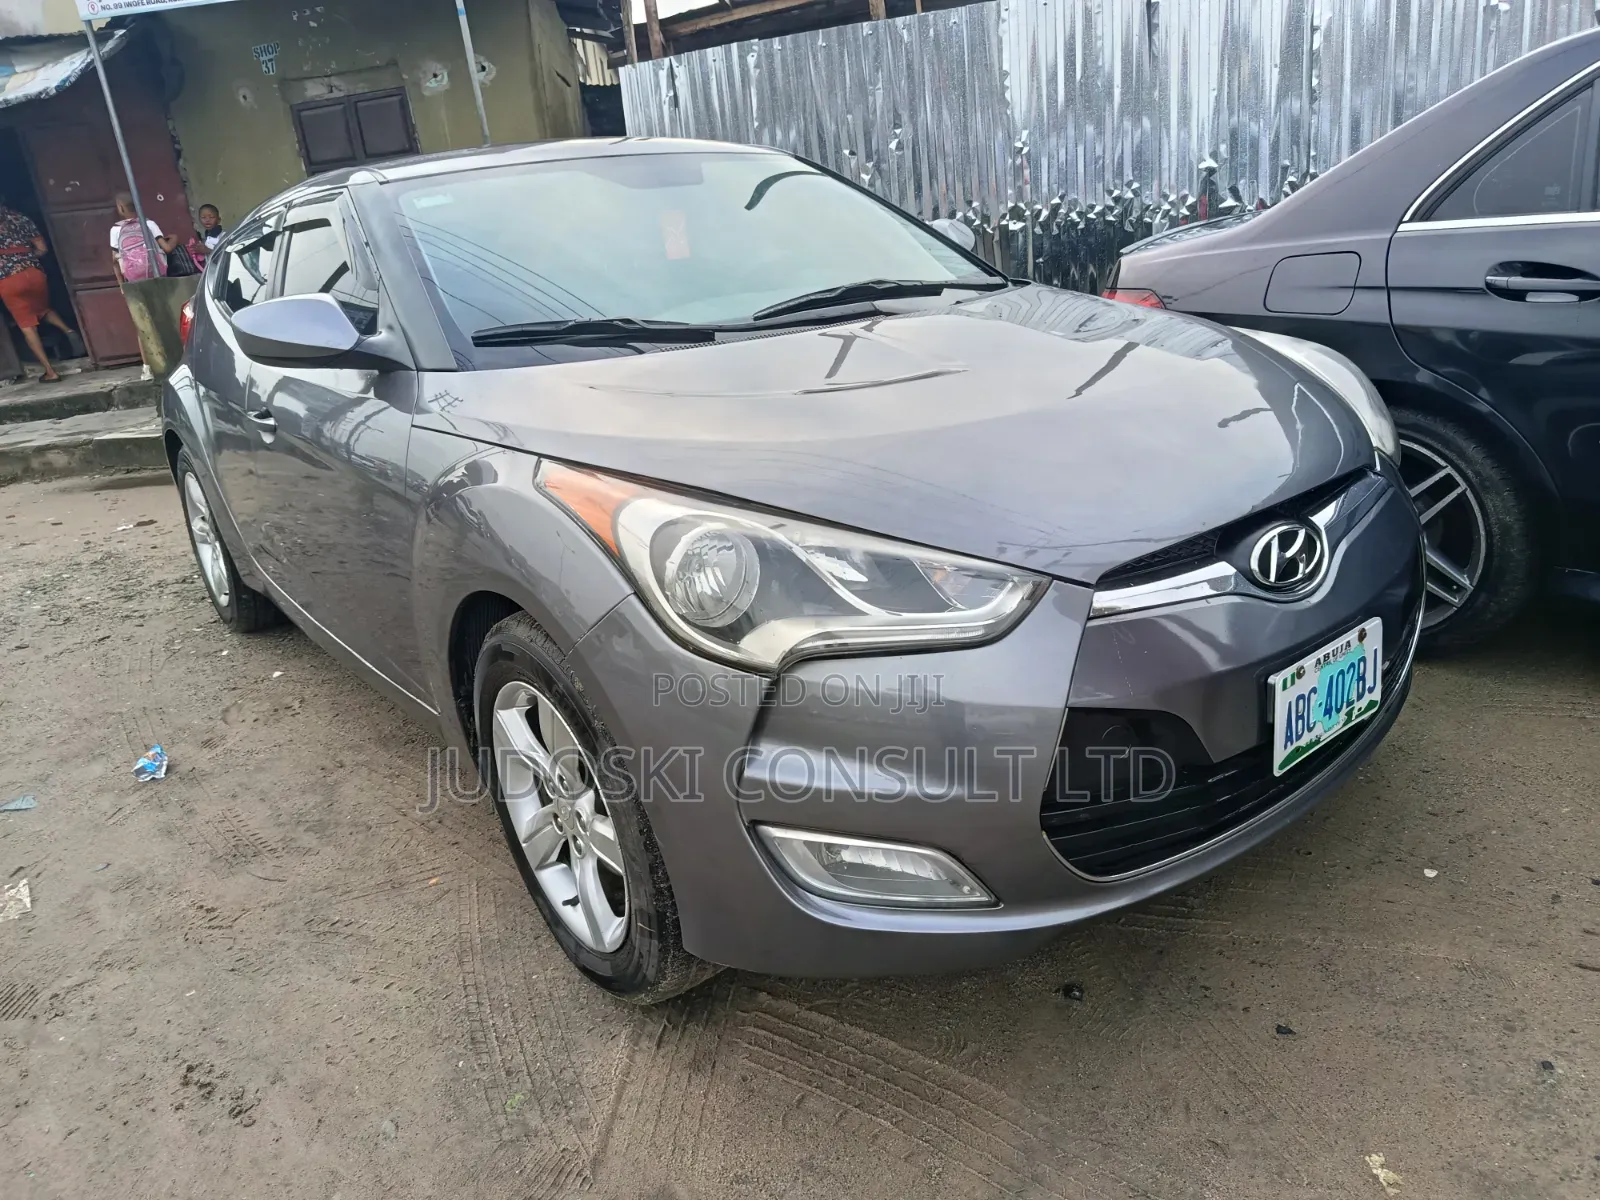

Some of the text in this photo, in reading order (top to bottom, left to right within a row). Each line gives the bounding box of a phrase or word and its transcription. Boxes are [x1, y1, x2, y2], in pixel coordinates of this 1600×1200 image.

[253, 42, 280, 58] SHOP
[262, 58, 275, 74] 37
[1313, 640, 1352, 668] ABUJA
